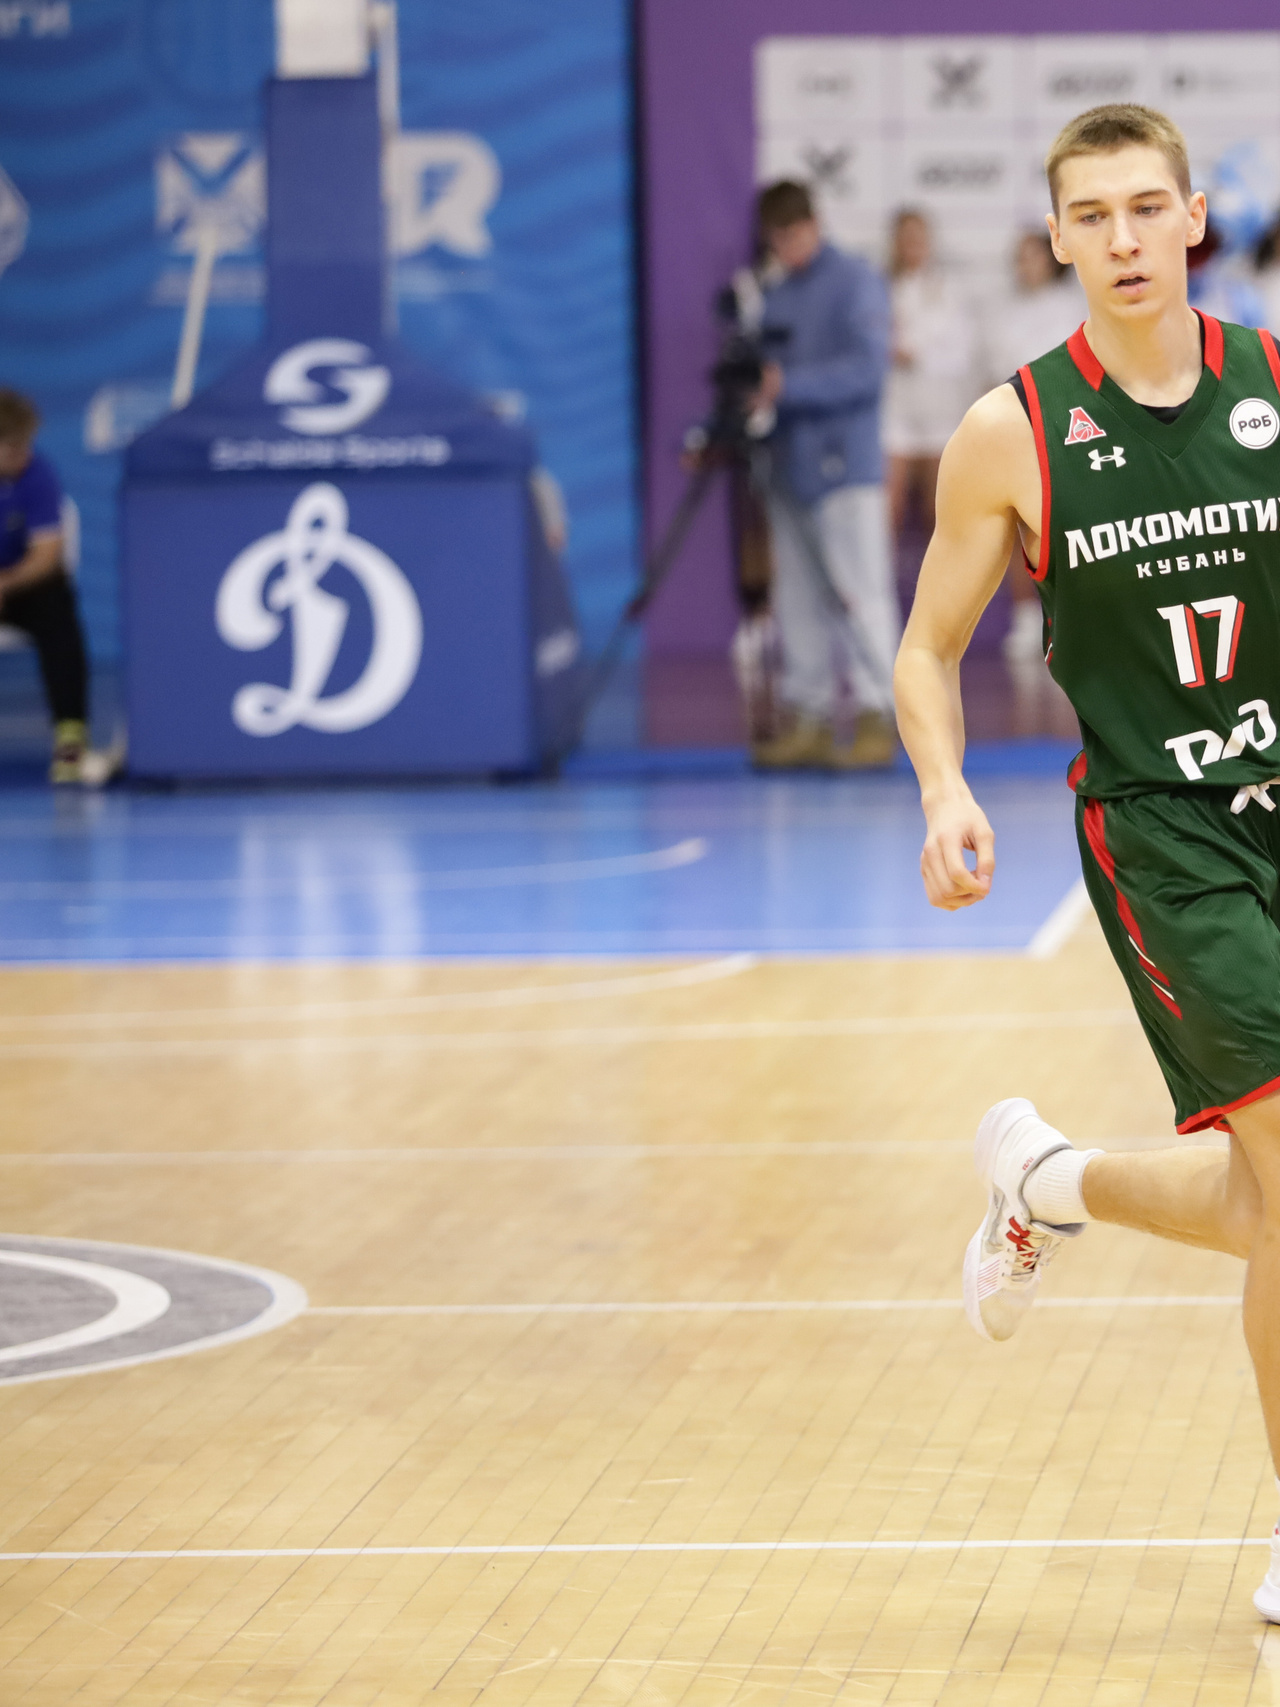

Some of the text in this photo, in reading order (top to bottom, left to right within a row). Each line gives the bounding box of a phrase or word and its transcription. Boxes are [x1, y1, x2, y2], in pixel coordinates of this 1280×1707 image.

[1237, 414, 1273, 433] РФБ
[1135, 548, 1246, 579] КУБАНЬ
[1156, 595, 1245, 688] 17
